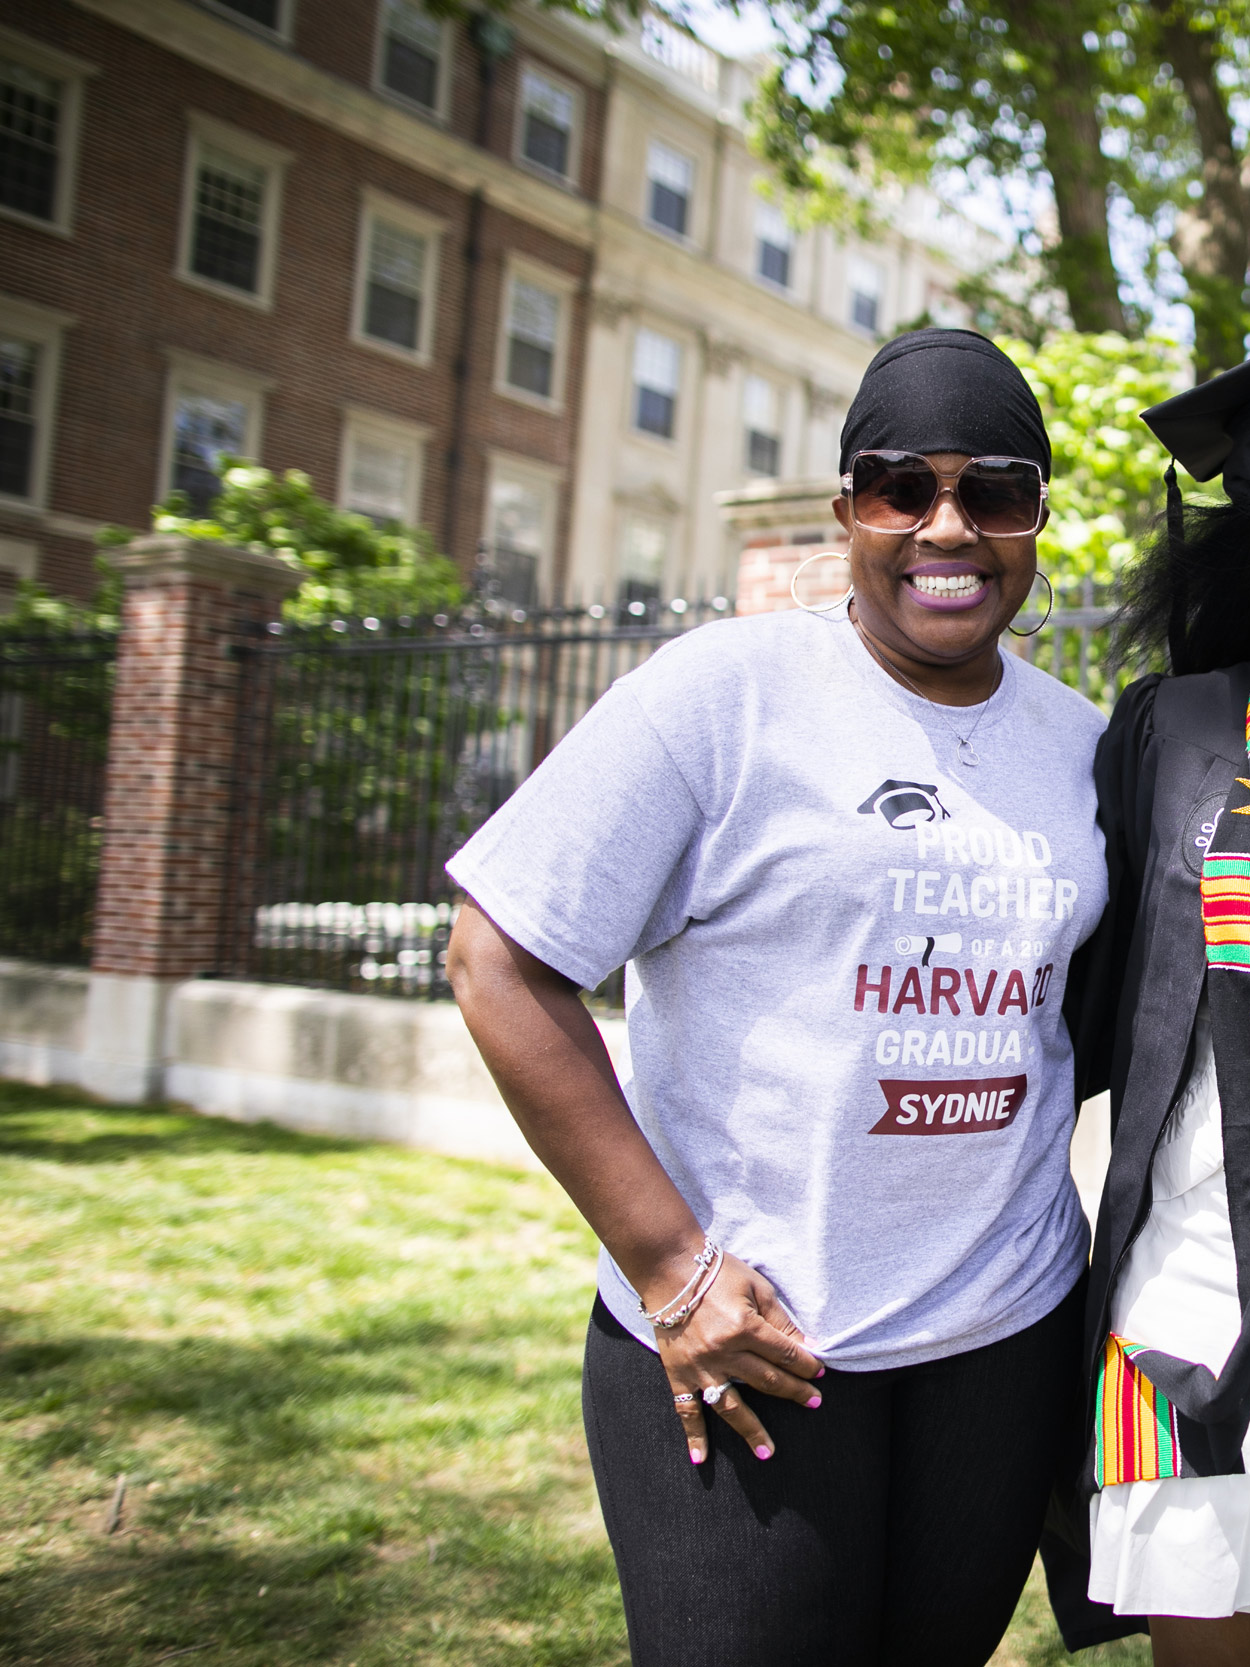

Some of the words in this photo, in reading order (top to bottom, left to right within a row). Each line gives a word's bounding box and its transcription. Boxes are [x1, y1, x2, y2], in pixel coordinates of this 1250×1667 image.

[914, 822, 1053, 869] PROUD
[887, 868, 1079, 921] TEACHER
[971, 938, 995, 957] OF
[1001, 938, 1014, 957] A
[1020, 939, 1052, 957] 20
[875, 1029, 1035, 1067] GRADUA
[895, 1087, 1016, 1125] SYDNIE
